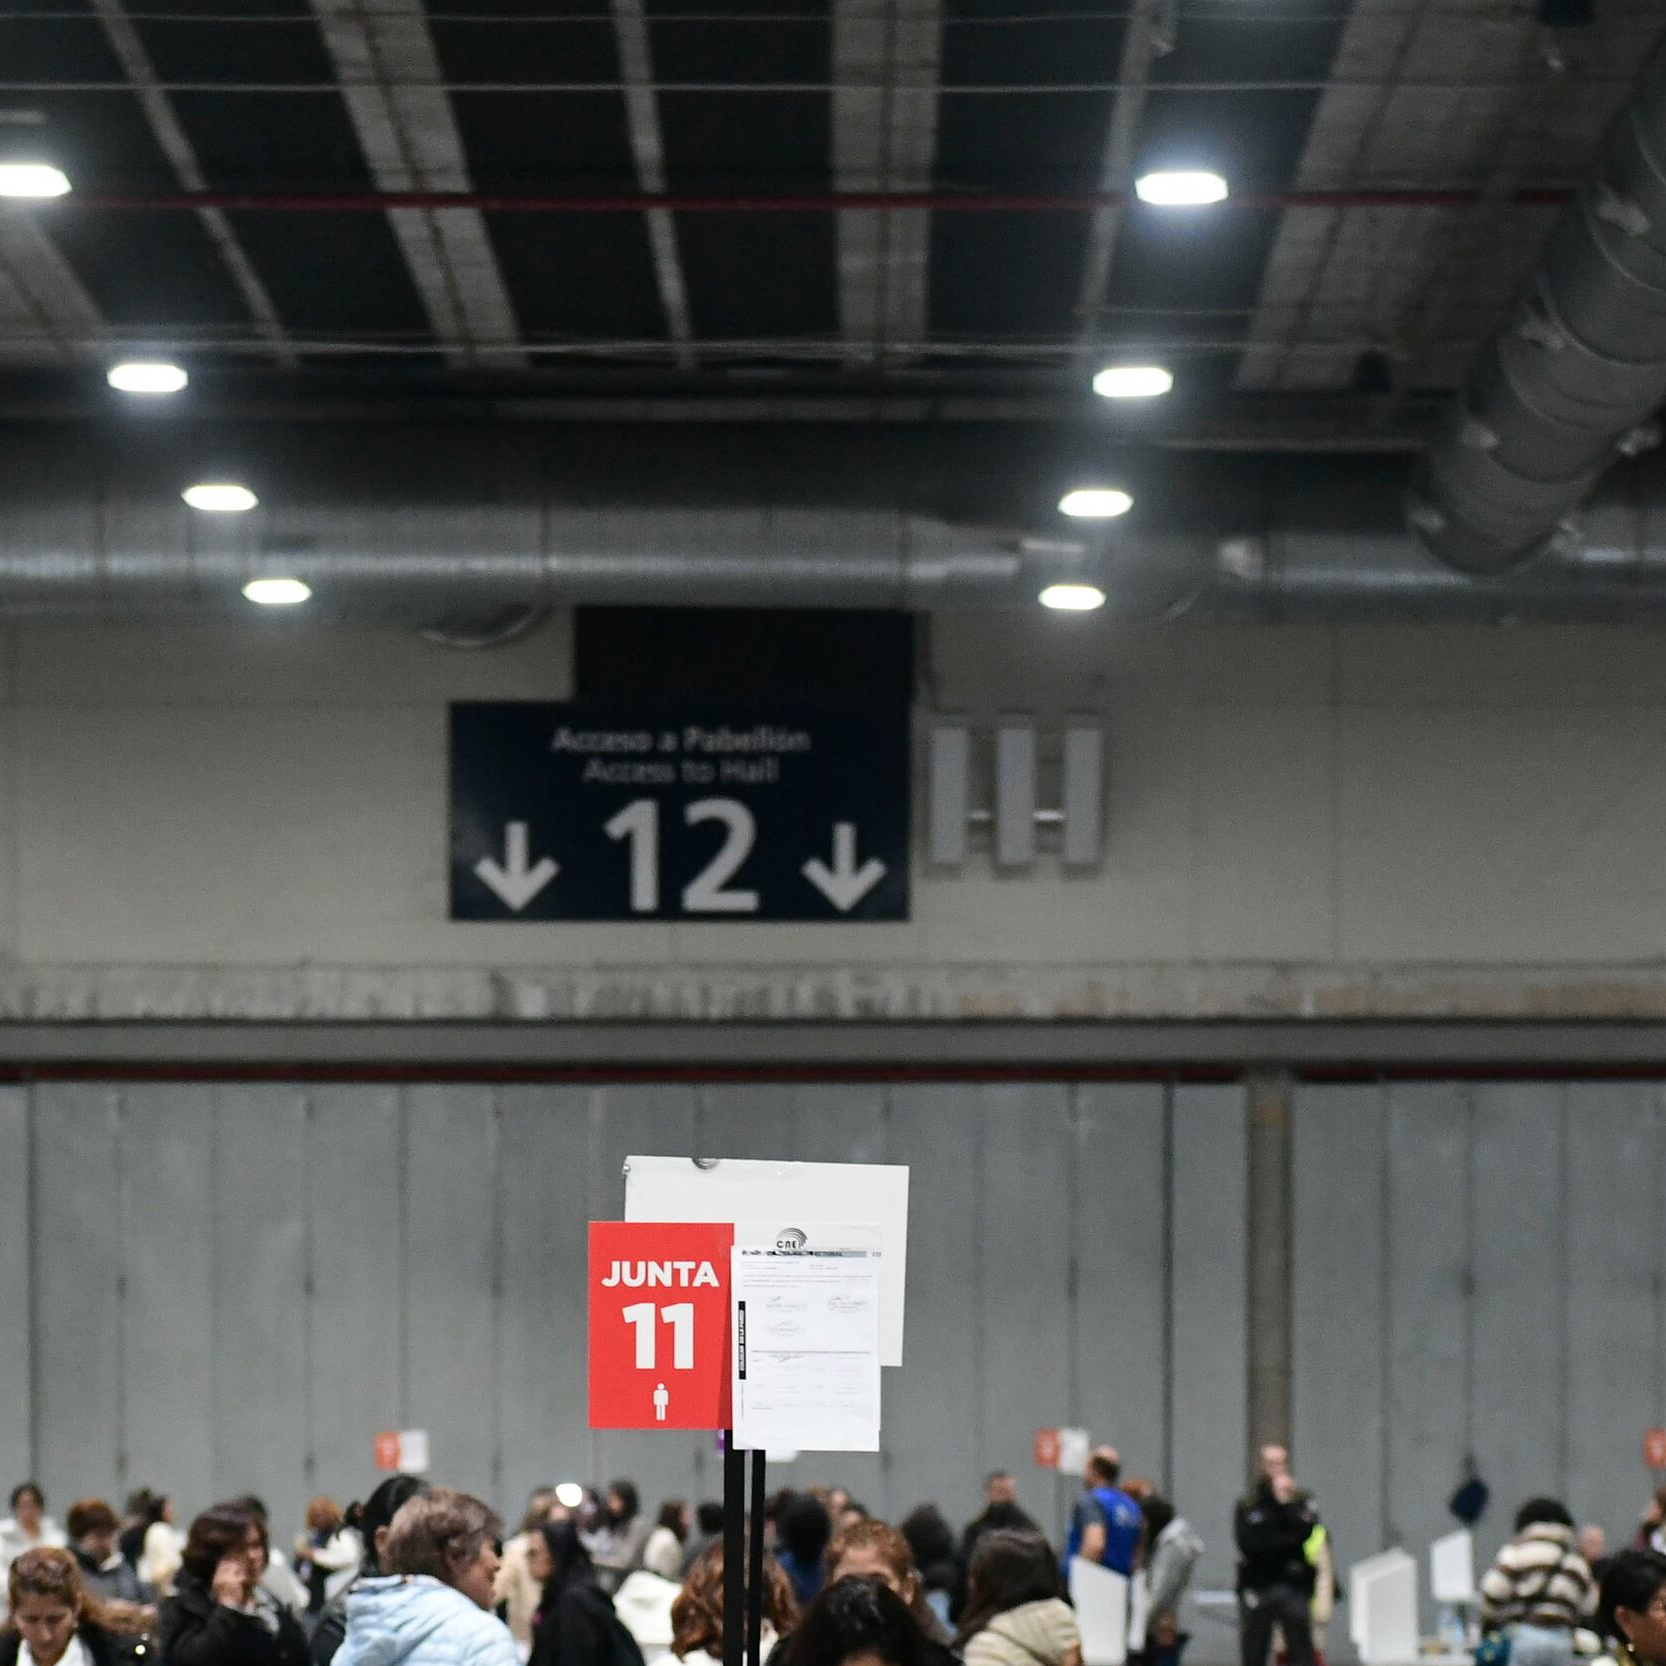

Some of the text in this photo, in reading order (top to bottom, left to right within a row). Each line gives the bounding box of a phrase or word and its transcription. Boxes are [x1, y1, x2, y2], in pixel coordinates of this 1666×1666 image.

[552, 728, 653, 751] Acceso
[659, 732, 678, 751] a
[585, 760, 779, 782] Access to Hall
[604, 797, 759, 912] 12
[601, 1261, 720, 1287] JUNTA
[622, 1302, 694, 1369] 11
